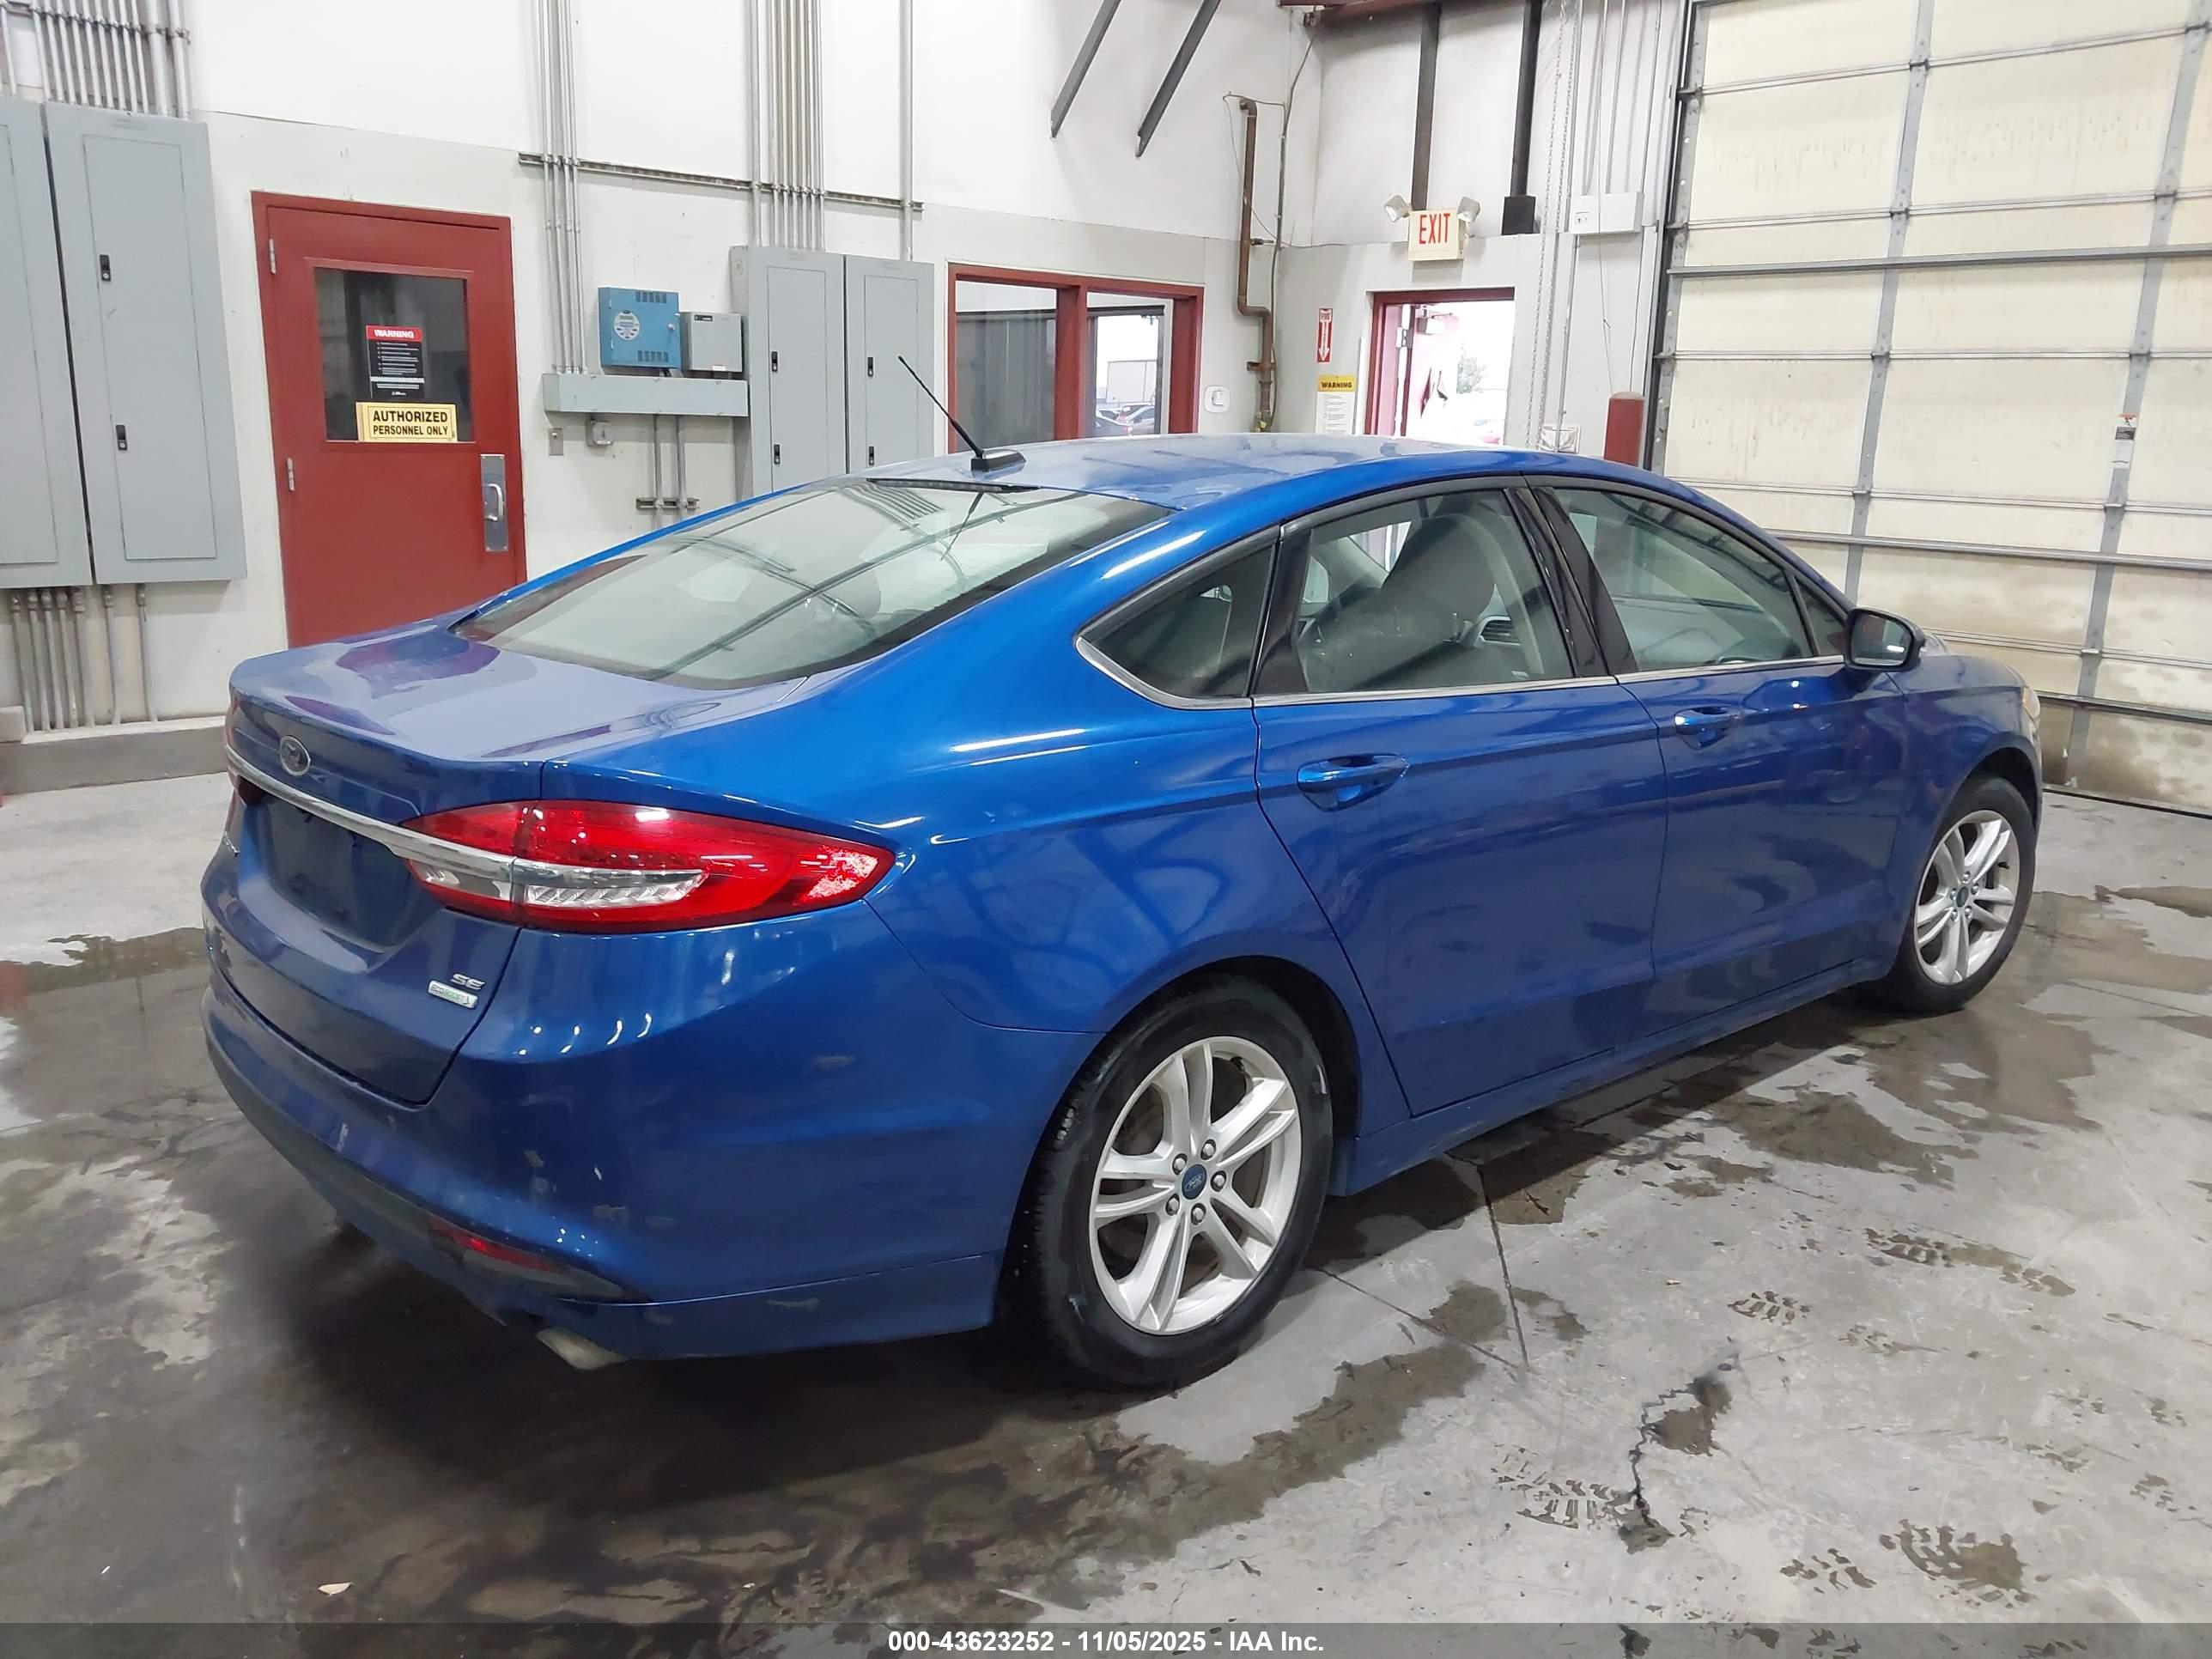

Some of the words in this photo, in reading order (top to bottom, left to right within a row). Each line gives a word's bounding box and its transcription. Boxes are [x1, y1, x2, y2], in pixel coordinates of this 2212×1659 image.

[1419, 213, 1451, 244] EXIT
[374, 329, 415, 339] WARNING
[373, 410, 448, 423] AUTHORIZED
[373, 425, 424, 435] PERSONNEL
[426, 426, 448, 435] ONLY
[450, 973, 486, 990] SE
